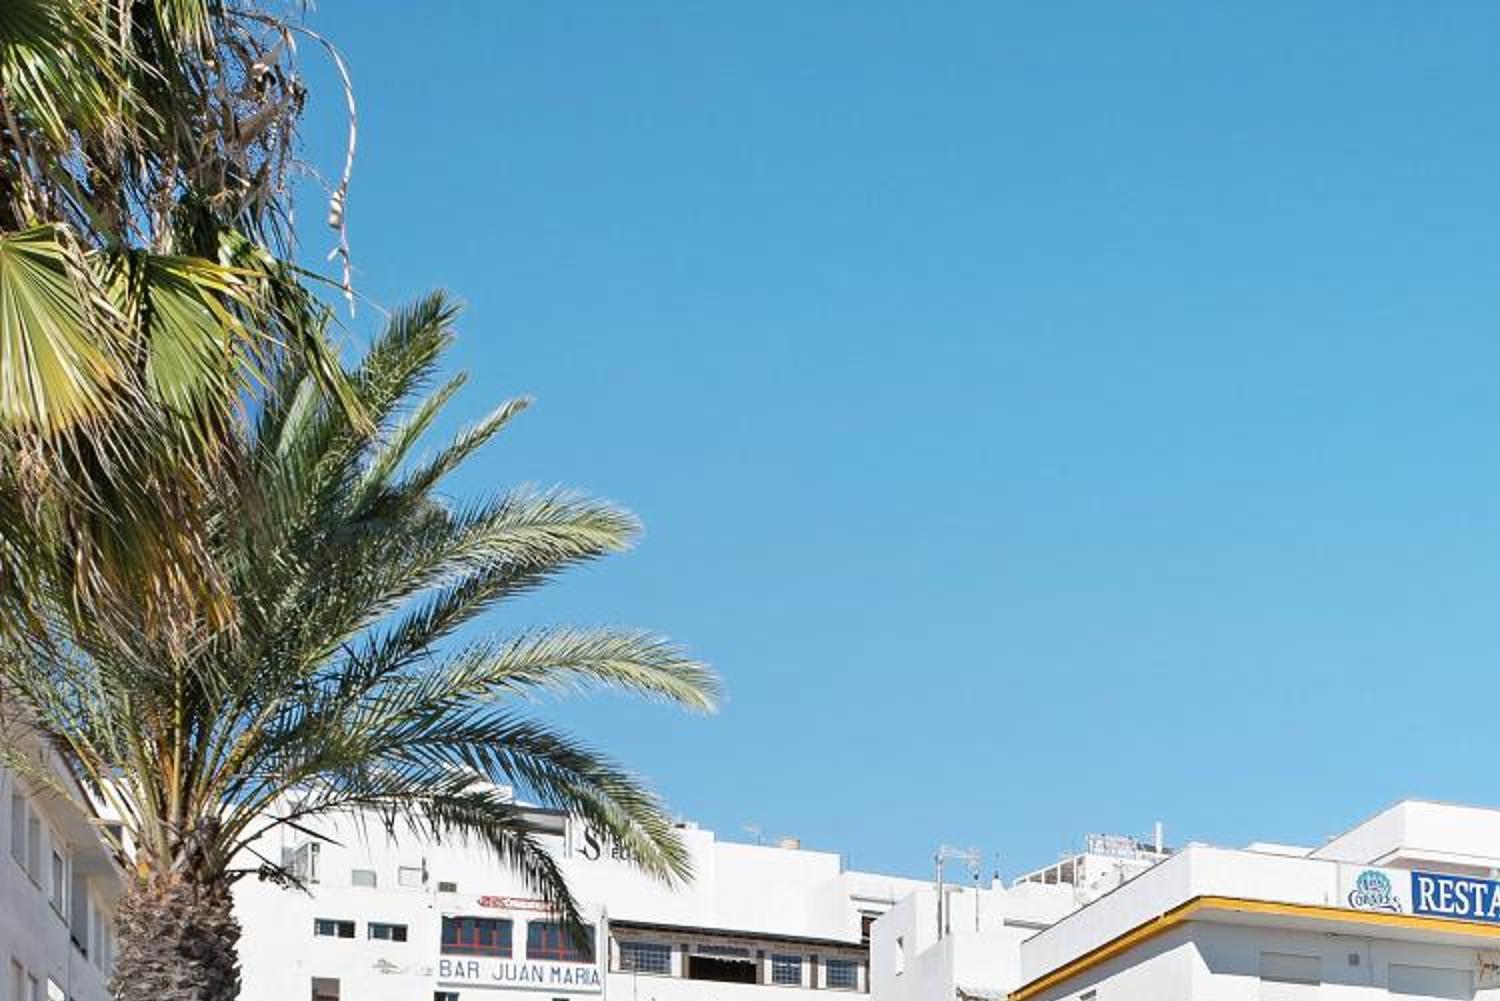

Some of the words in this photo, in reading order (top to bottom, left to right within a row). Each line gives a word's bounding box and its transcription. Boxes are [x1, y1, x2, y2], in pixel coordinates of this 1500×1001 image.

[439, 959, 480, 979] BAR
[491, 962, 544, 983] JUAN
[550, 967, 601, 986] MARIA
